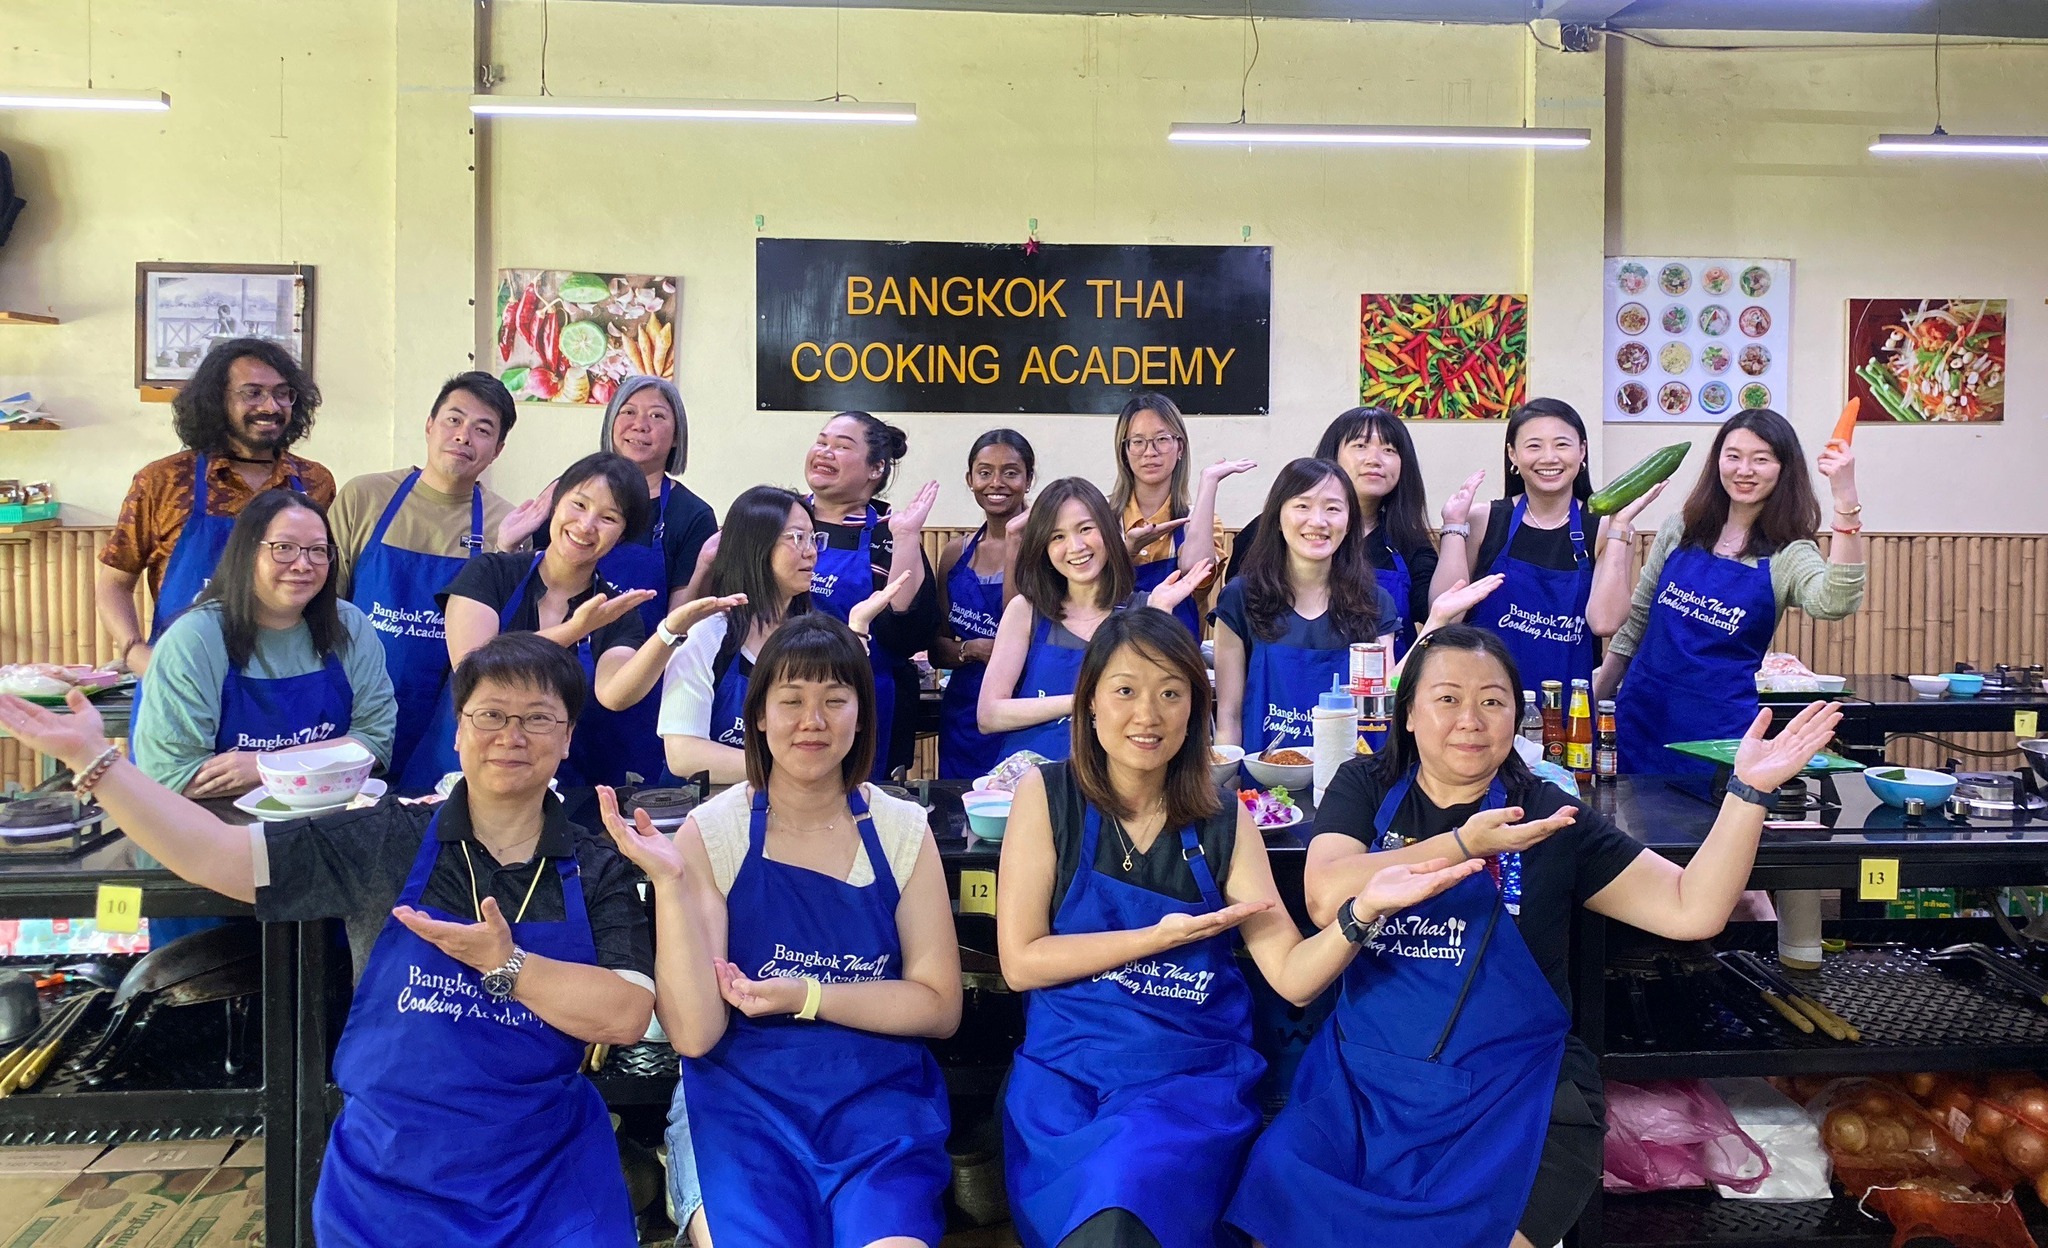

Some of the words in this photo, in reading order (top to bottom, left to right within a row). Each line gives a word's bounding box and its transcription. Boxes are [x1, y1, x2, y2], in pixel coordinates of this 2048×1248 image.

[846, 276, 1067, 318] BANGKOK
[1086, 279, 1184, 319] THAI
[790, 341, 1000, 384] COOKING
[1019, 344, 1237, 385] ACADEMY
[809, 583, 834, 598] demy
[1666, 581, 1708, 609] Bangkok
[1707, 598, 1735, 617] Thai
[372, 601, 423, 623] Bangkok
[422, 610, 446, 626] Tha
[948, 610, 972, 631] Cooking
[970, 622, 998, 638] Acade
[951, 601, 982, 622] Bangkok
[1509, 603, 1558, 628] Bangkok
[1657, 590, 1691, 617] Cooking
[1689, 607, 1740, 636] Academy
[404, 623, 447, 640] Acade
[1498, 613, 1542, 640] Cooking
[1268, 703, 1314, 724] Bangkok
[2019, 719, 2026, 729] 7
[1262, 715, 1302, 740] Cooking
[237, 732, 301, 752] Bangkok
[970, 883, 989, 898] 12
[1868, 871, 1885, 885] 13
[107, 899, 127, 915] 10
[1406, 915, 1448, 937] Thai
[773, 943, 841, 970] Bangkok
[843, 954, 877, 972] Thai
[1388, 939, 1466, 967] Academy
[408, 964, 484, 1000] Bangko
[1124, 960, 1161, 978] gkok
[1162, 962, 1199, 983] Thai
[397, 986, 463, 1023] Cooking
[1141, 979, 1210, 1005] Academy
